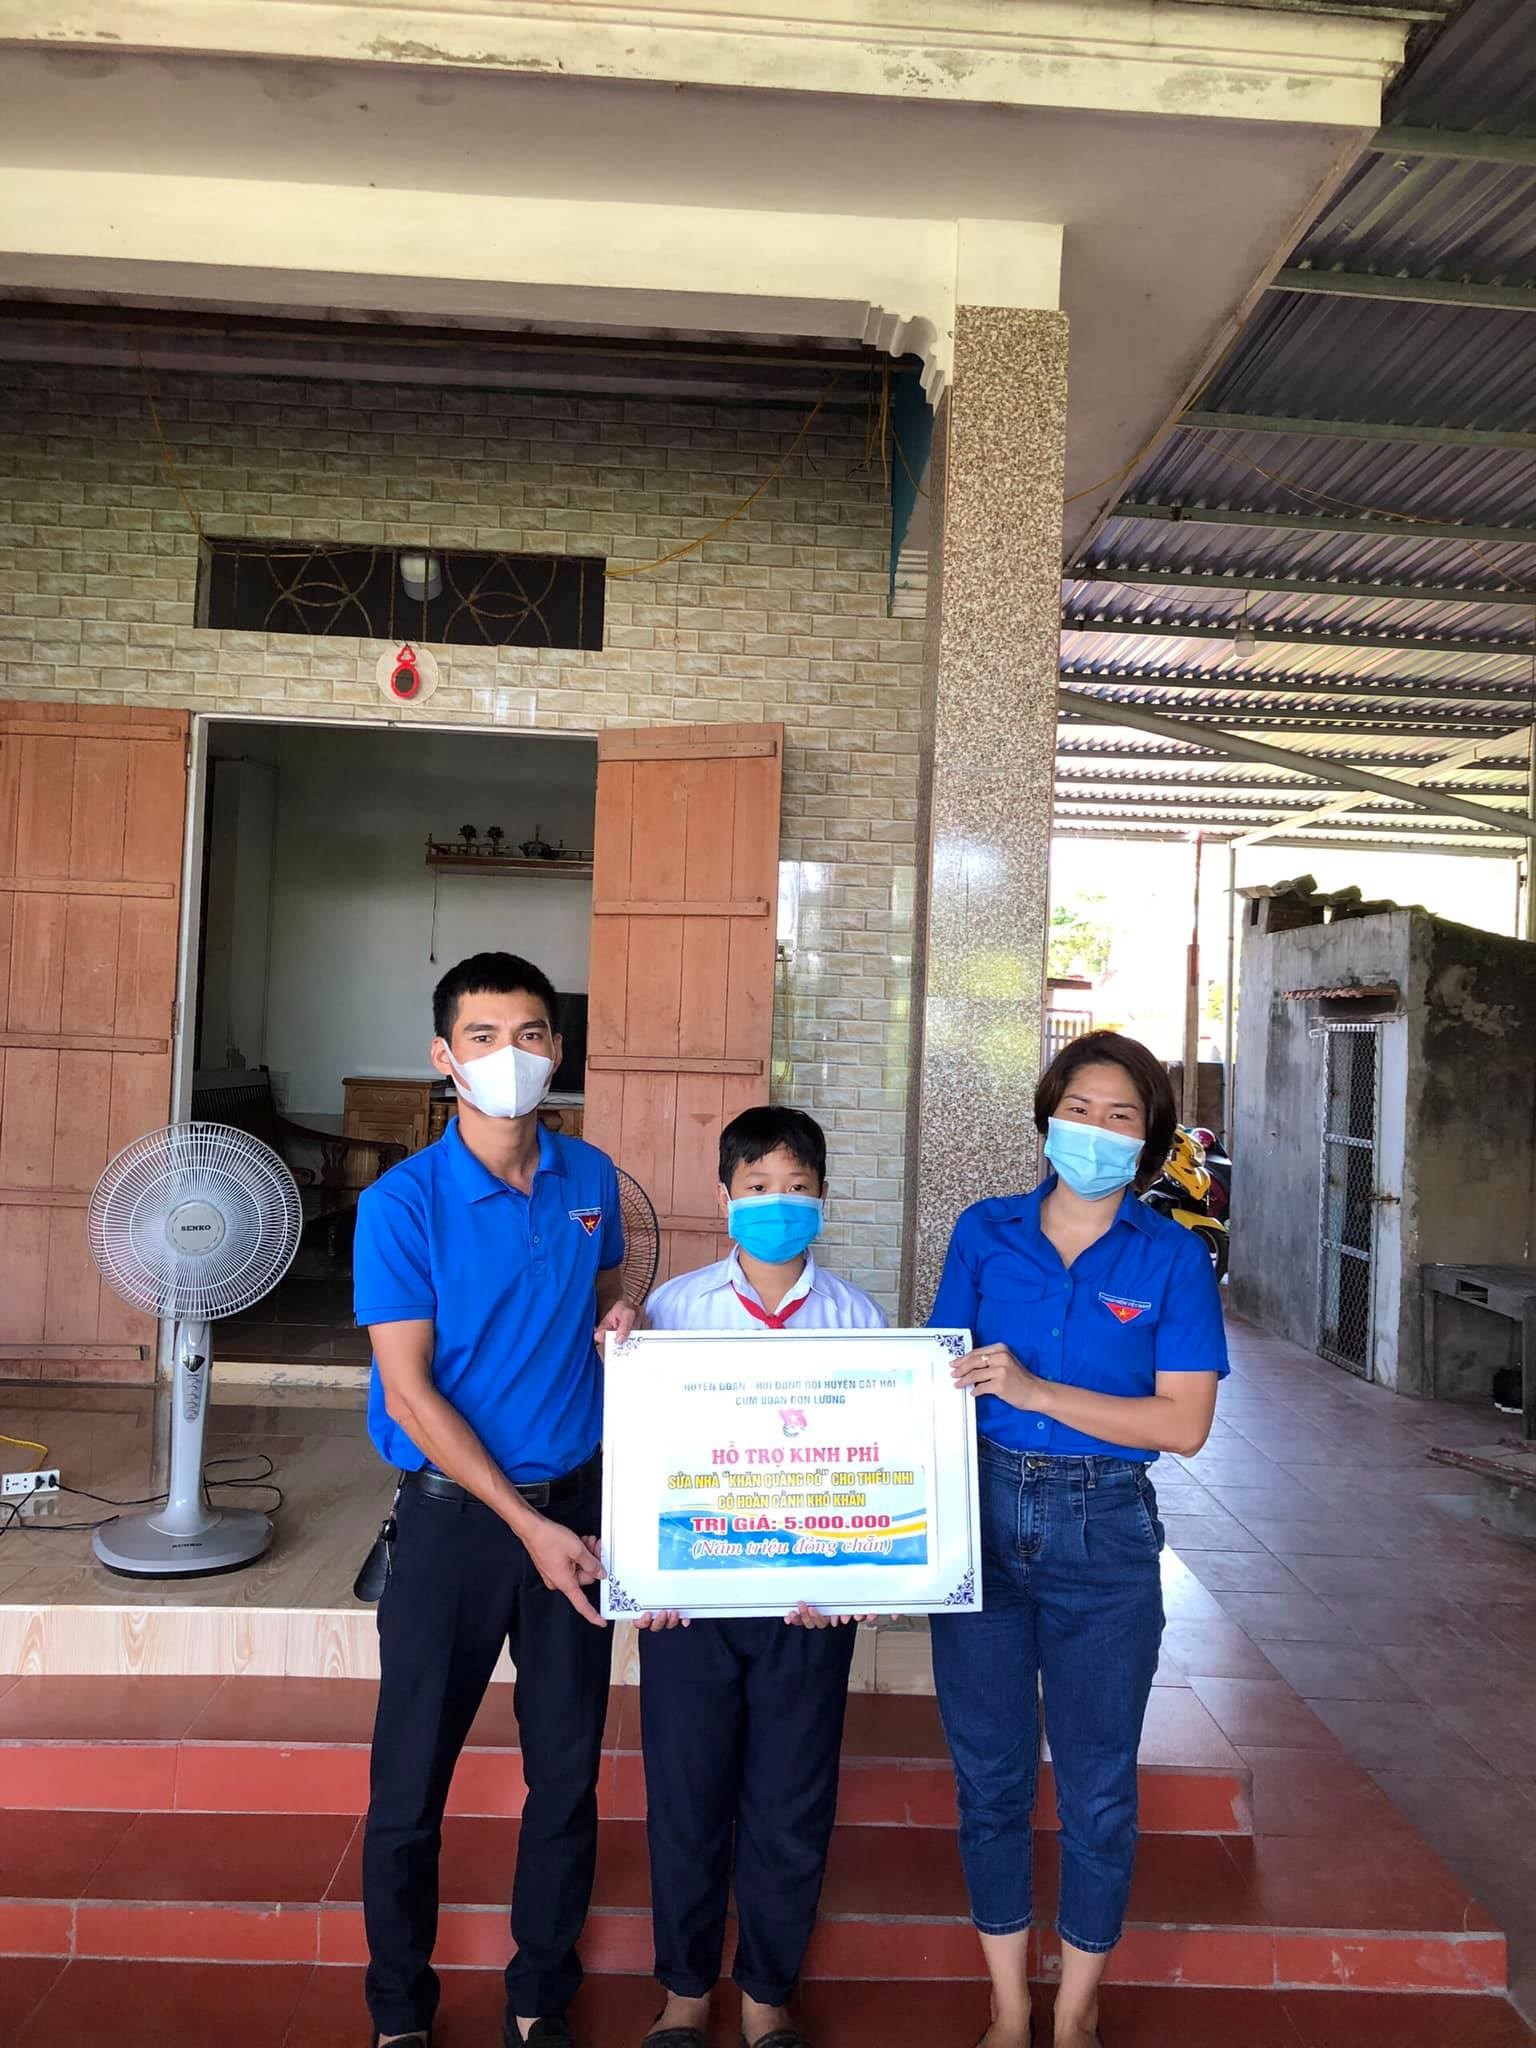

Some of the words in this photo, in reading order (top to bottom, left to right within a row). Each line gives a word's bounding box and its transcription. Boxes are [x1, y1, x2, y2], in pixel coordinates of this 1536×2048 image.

[712, 1440, 740, 1465] HỖ
[745, 1446, 785, 1468] TRỢ
[790, 1446, 840, 1463] KINH
[846, 1442, 880, 1463] PHÍ
[668, 1471, 693, 1489] SỬA
[695, 1471, 720, 1489] NHÀ
[764, 1470, 803, 1488] QUÀNG
[831, 1471, 856, 1486] CHO
[857, 1467, 891, 1486] THIẾU
[892, 1471, 914, 1485] NHI
[718, 1492, 735, 1510] CÓ
[736, 1491, 770, 1509] HOÀN
[771, 1489, 804, 1508] CẢNH
[806, 1491, 831, 1508] KHÓ
[832, 1490, 866, 1507] KHĂN
[692, 1517, 727, 1535] TRỊ
[693, 1540, 741, 1557] (Năm
[746, 1539, 788, 1556] triệu
[793, 1536, 836, 1555] đồng
[841, 1535, 892, 1554] chẵn)
